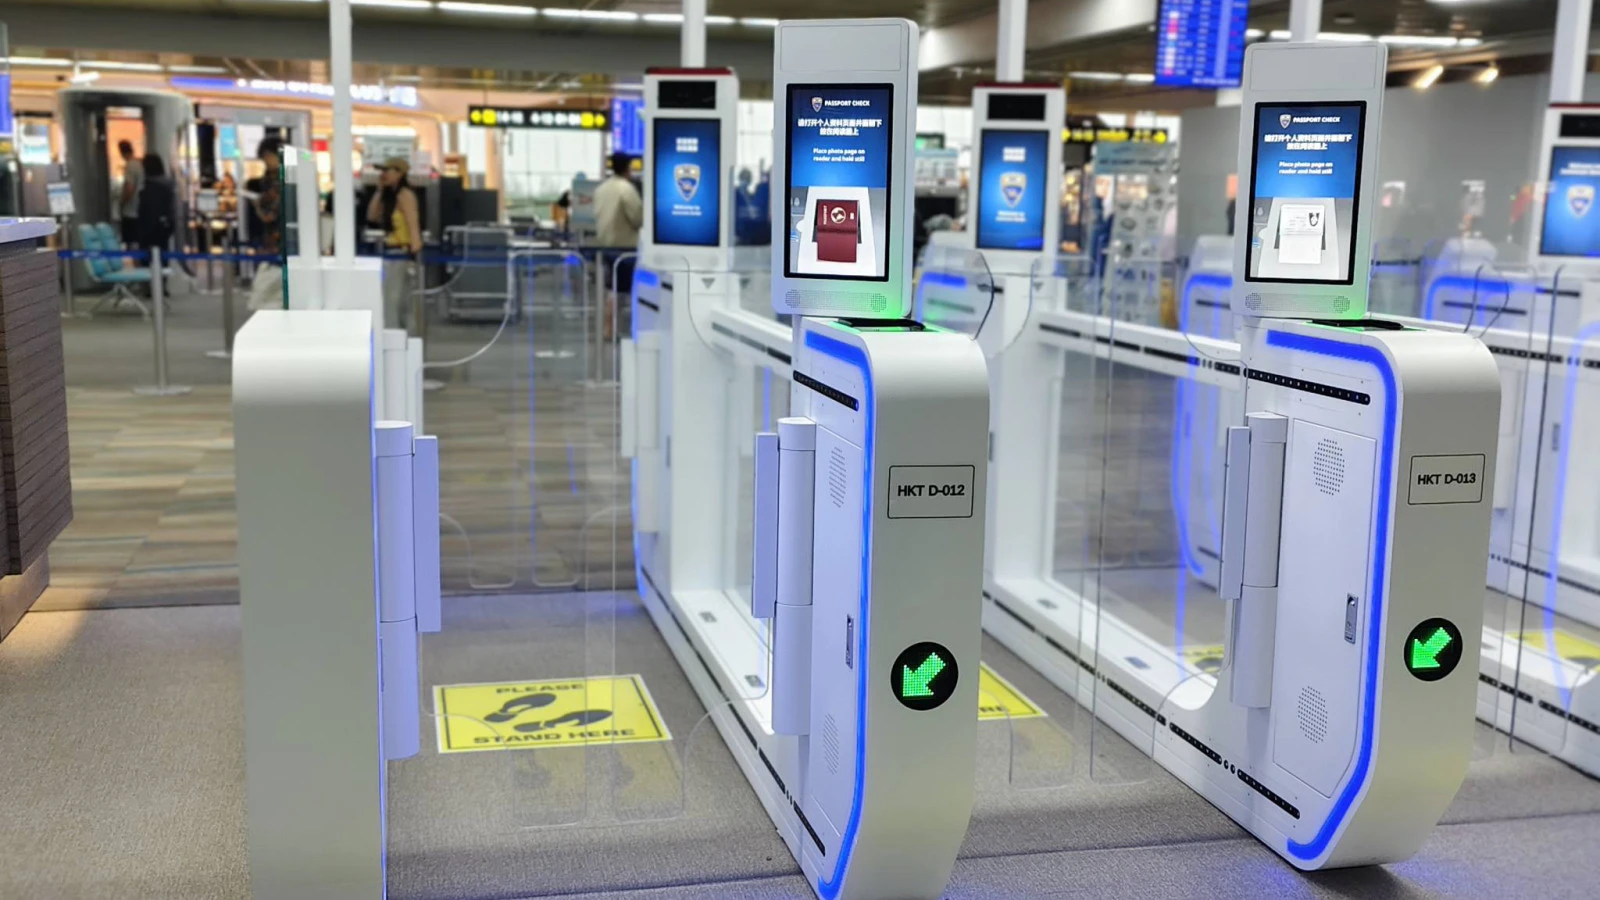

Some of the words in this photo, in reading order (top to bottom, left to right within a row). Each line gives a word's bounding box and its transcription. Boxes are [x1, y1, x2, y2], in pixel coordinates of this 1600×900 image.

[1417, 474, 1442, 485] HKT
[1444, 473, 1476, 484] D-013
[897, 485, 925, 496] HKT
[928, 484, 965, 496] D-012
[496, 684, 584, 694] PLEASE
[474, 733, 562, 744] STAND
[568, 729, 636, 739] HERE
